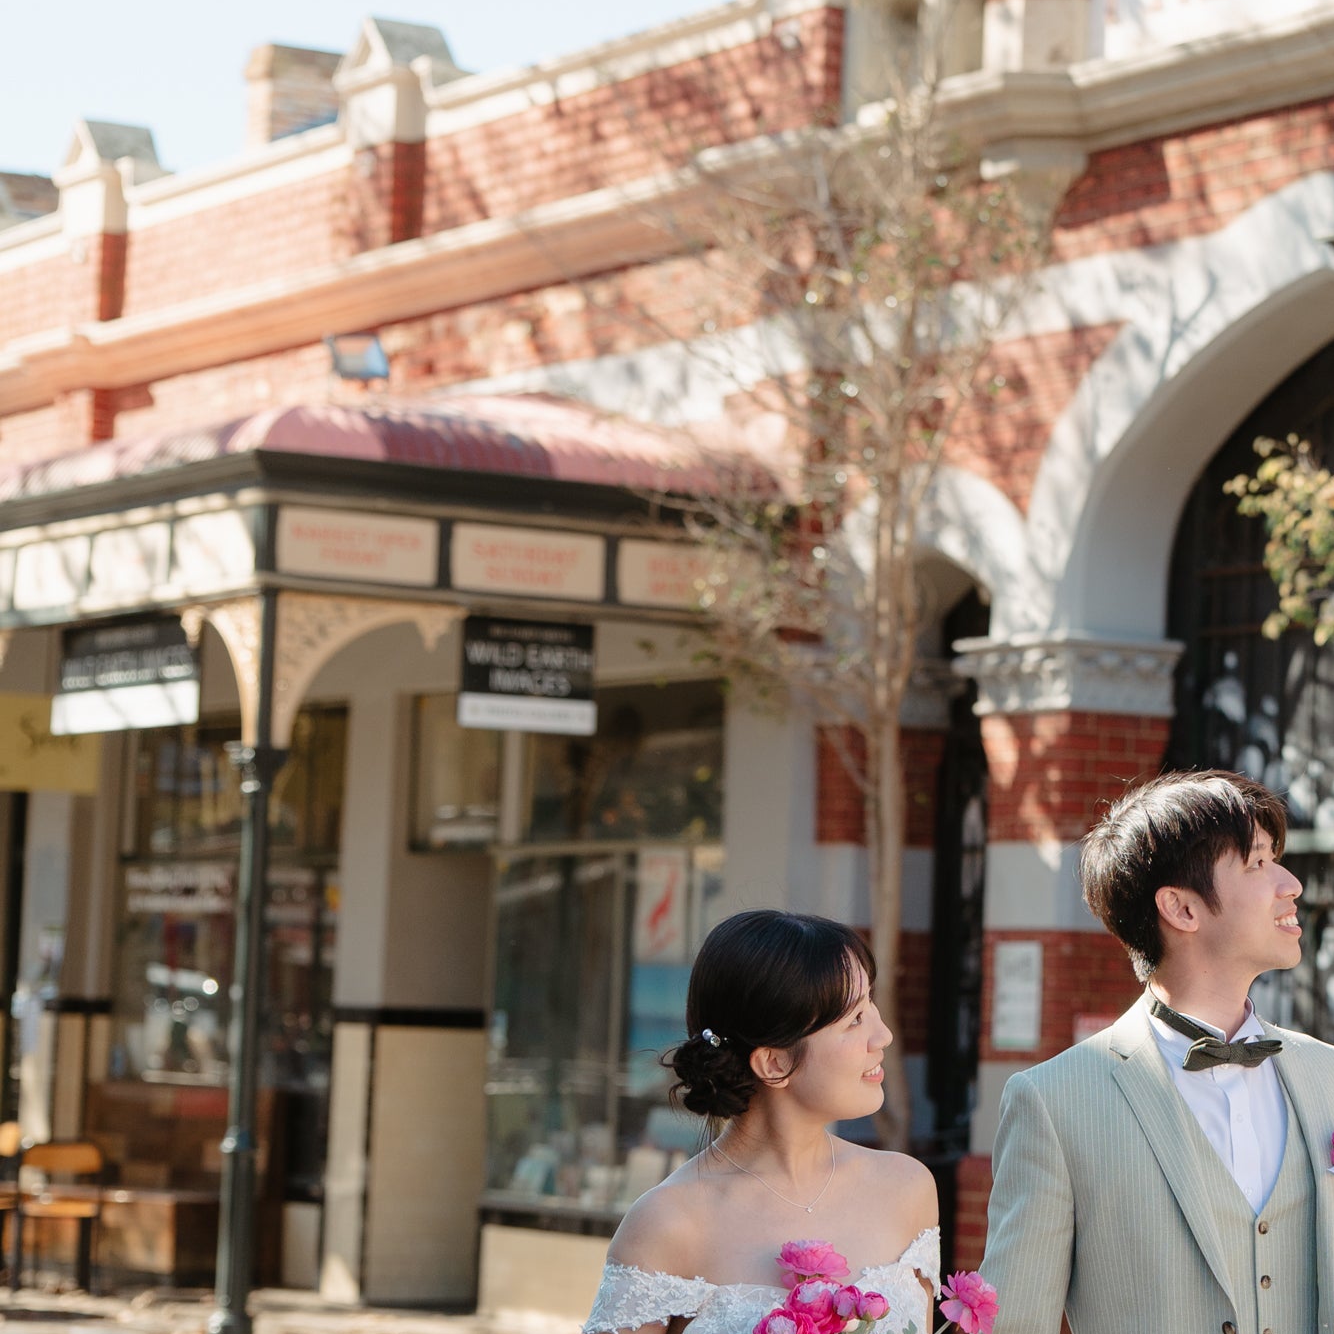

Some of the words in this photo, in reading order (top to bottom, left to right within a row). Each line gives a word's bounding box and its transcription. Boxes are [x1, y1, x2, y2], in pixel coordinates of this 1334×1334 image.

[465, 641, 524, 668] WILD
[525, 644, 593, 670] EARTH
[488, 667, 571, 697] IMAGES
